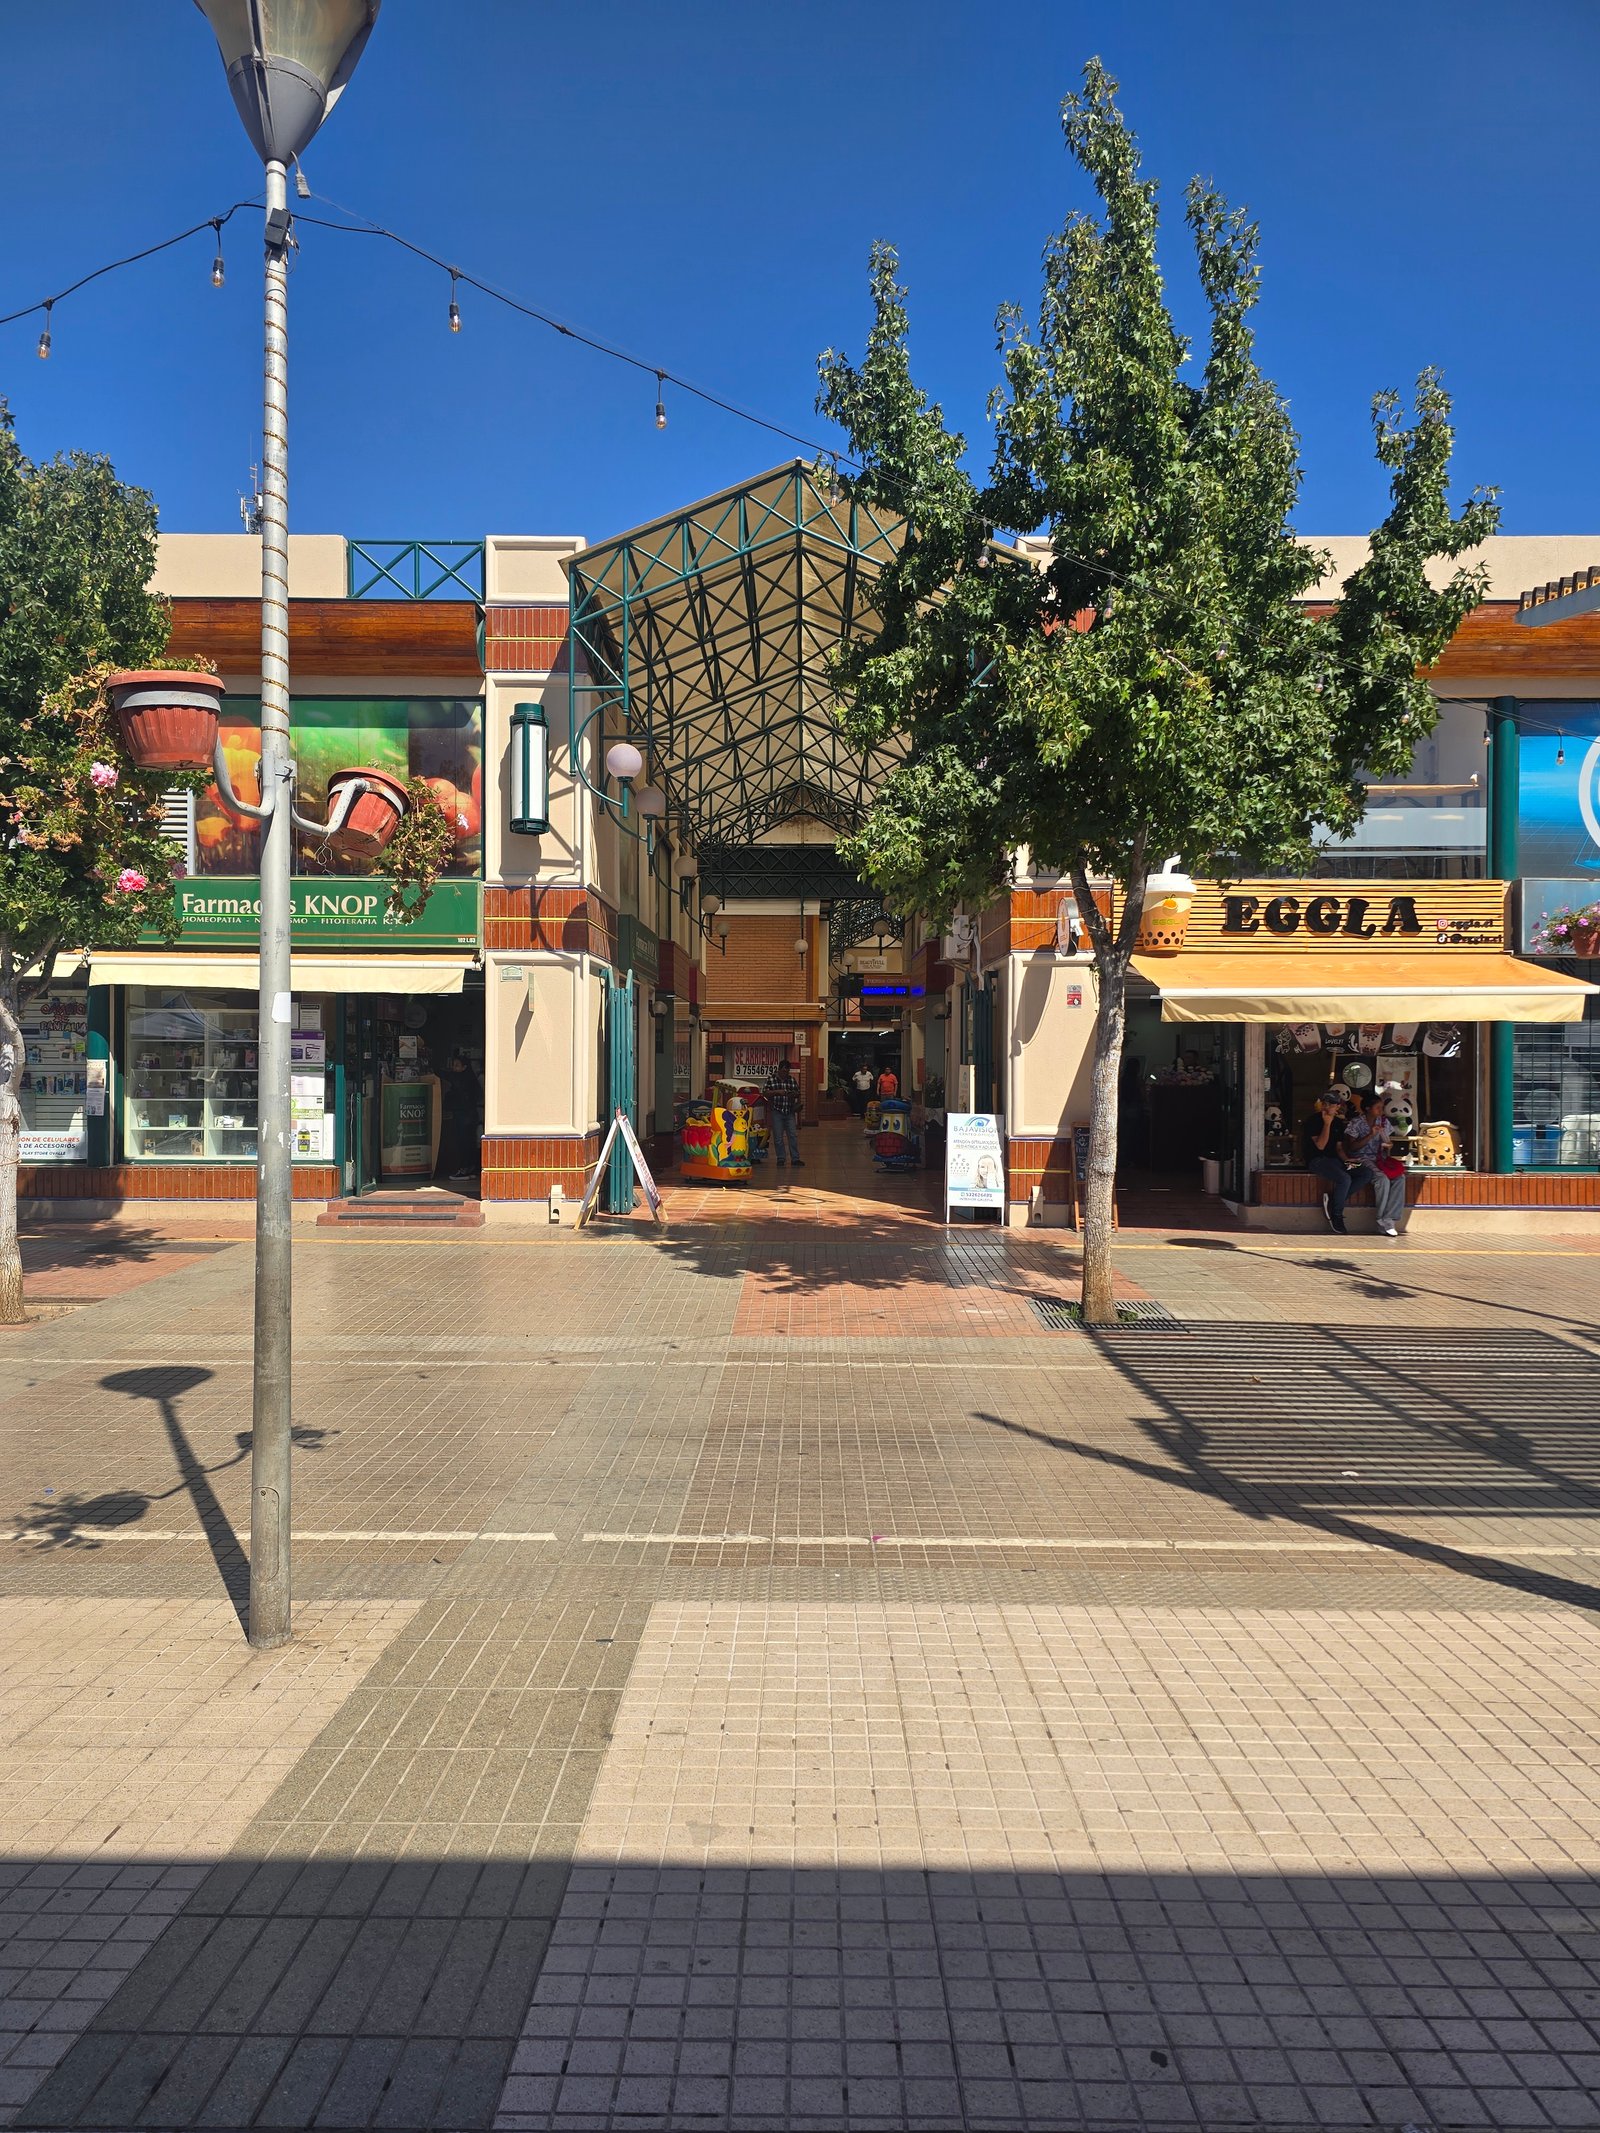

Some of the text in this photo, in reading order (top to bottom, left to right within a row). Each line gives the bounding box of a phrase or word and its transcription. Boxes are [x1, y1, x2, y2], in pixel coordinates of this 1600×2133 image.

[182, 893, 378, 915] Farmacs KNOP
[182, 916, 242, 924] HOMEOPATIA
[1222, 896, 1423, 936] EGGLA
[735, 1047, 779, 1065] SE ARRIENDA
[736, 1065, 778, 1076] 9 75546792
[400, 1109, 425, 1118] KNOP
